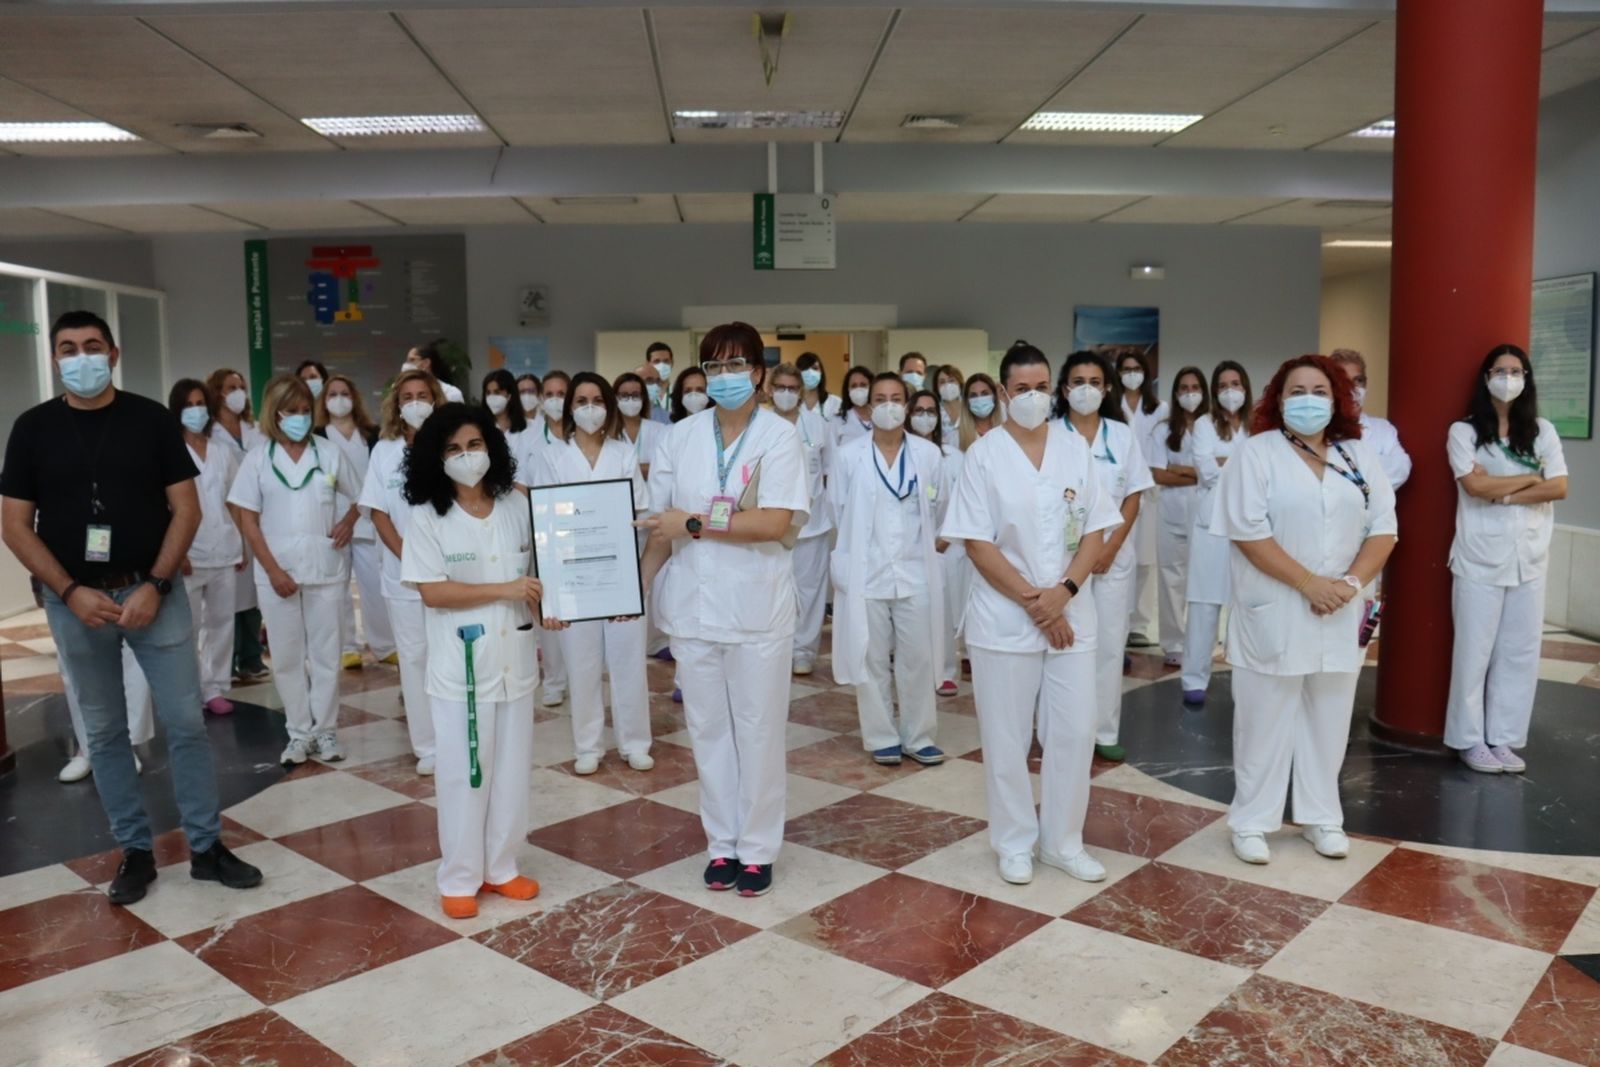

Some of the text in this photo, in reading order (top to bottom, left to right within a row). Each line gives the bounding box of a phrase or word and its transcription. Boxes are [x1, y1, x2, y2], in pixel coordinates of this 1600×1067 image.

[251, 252, 263, 349] Hospital de Poniente
